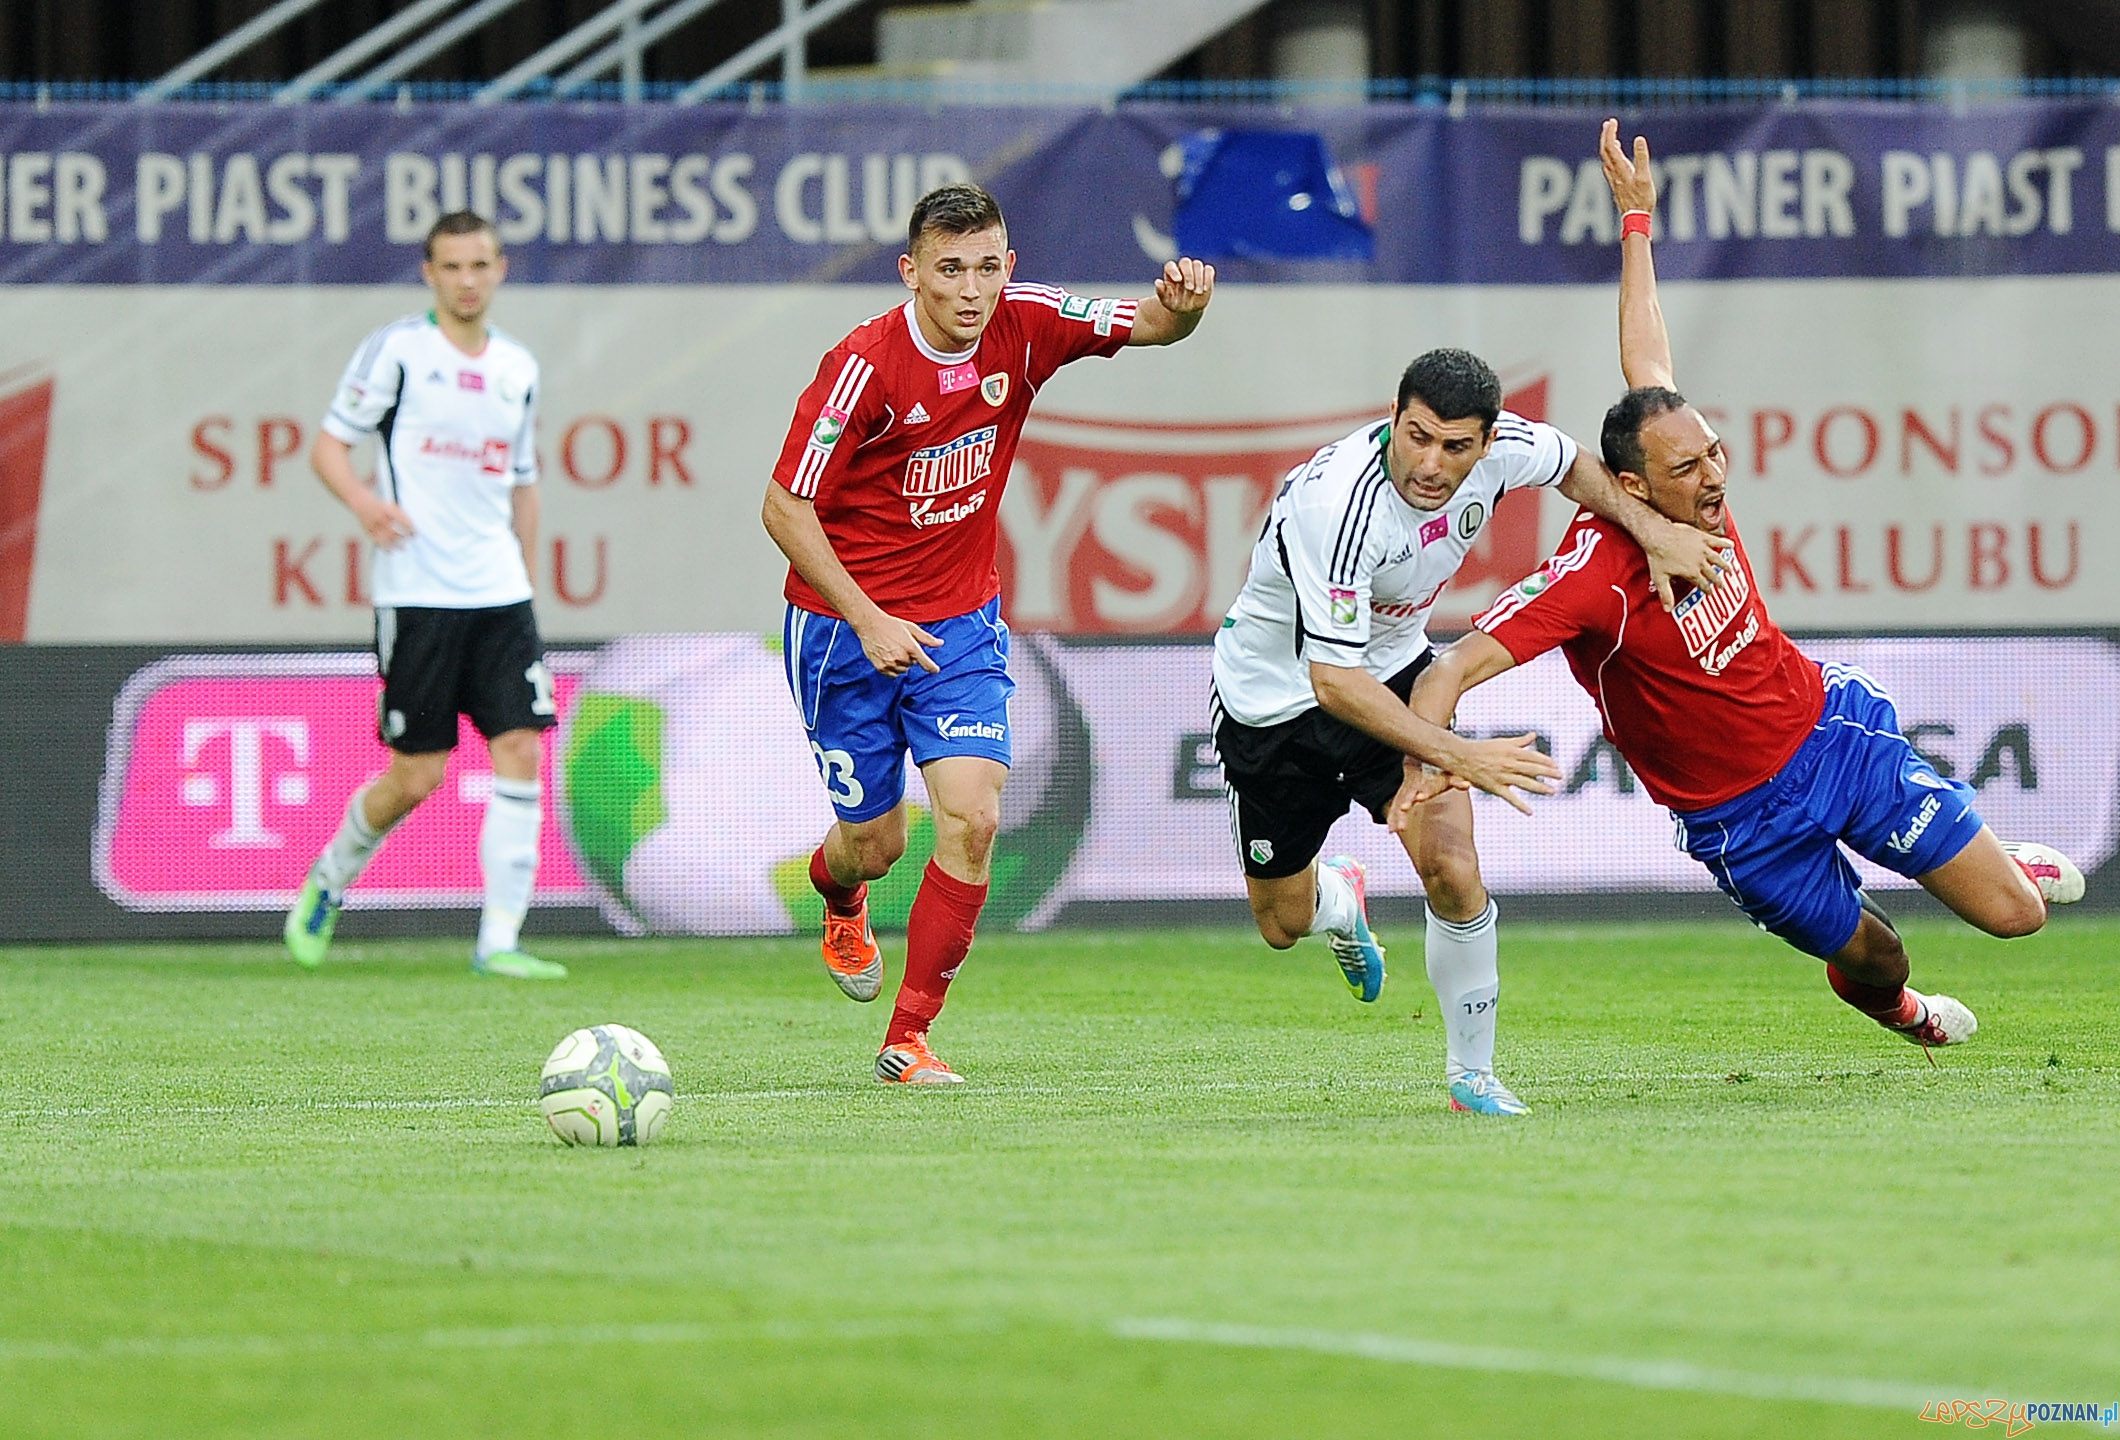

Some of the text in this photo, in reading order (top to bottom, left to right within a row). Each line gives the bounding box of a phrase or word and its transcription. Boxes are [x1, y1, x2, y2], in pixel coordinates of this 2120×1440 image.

[0, 151, 109, 244] ER
[135, 151, 361, 244] PIAST
[384, 152, 758, 244] BUSINESS
[1519, 151, 1856, 246] PATNER
[1883, 146, 2084, 238] PIAST
[189, 415, 696, 491] SPOR
[905, 440, 993, 494] GLIWICE
[915, 430, 993, 458] MIASTO
[1702, 402, 2120, 479] PONSO
[272, 534, 608, 609] KLU
[1769, 521, 2080, 612] KLUBU
